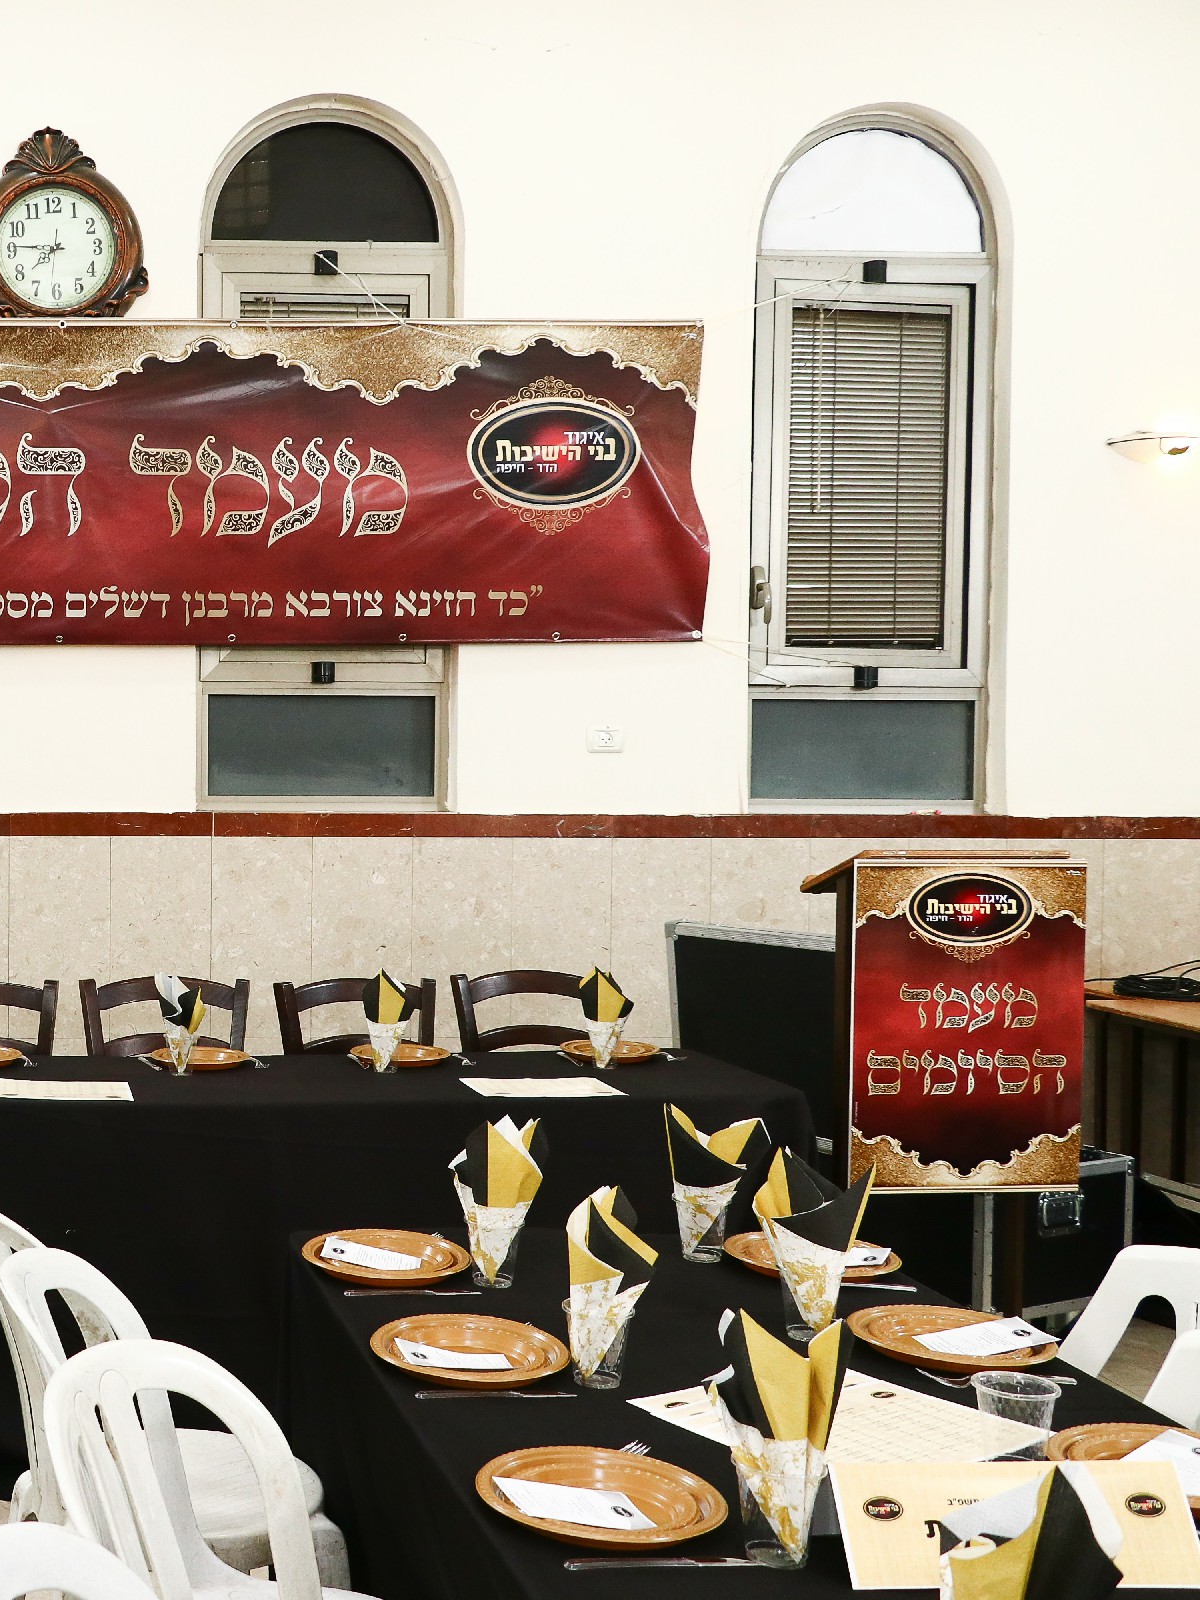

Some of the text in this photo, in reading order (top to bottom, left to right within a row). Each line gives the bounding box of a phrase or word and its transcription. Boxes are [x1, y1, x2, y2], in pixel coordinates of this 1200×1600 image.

[25, 202, 41, 220] 11
[44, 196, 62, 214] 12
[70, 202, 79, 219] 1
[9, 220, 25, 238] 10
[85, 217, 96, 235] 2
[6, 242, 17, 260] 9
[92, 238, 103, 255] 3
[15, 263, 25, 281] 8
[86, 260, 97, 278] 4
[31, 280, 41, 297] 7
[51, 283, 62, 300] 6
[74, 277, 84, 295] 5
[564, 431, 605, 445] איגוד
[495, 437, 617, 462] בני הישיבות
[496, 463, 525, 473] חיפה
[536, 463, 558, 473] הדר
[129, 433, 409, 548] מעמד
[65, 585, 171, 619] דשלים
[181, 589, 274, 627] מרבנן
[285, 589, 384, 618] צורבא
[394, 589, 477, 618] חזינא
[926, 898, 1018, 915] בני הישיבות
[976, 894, 1008, 904] איגוד
[900, 982, 1039, 1034] מעמד
[866, 1048, 1067, 1096] הסיומים
